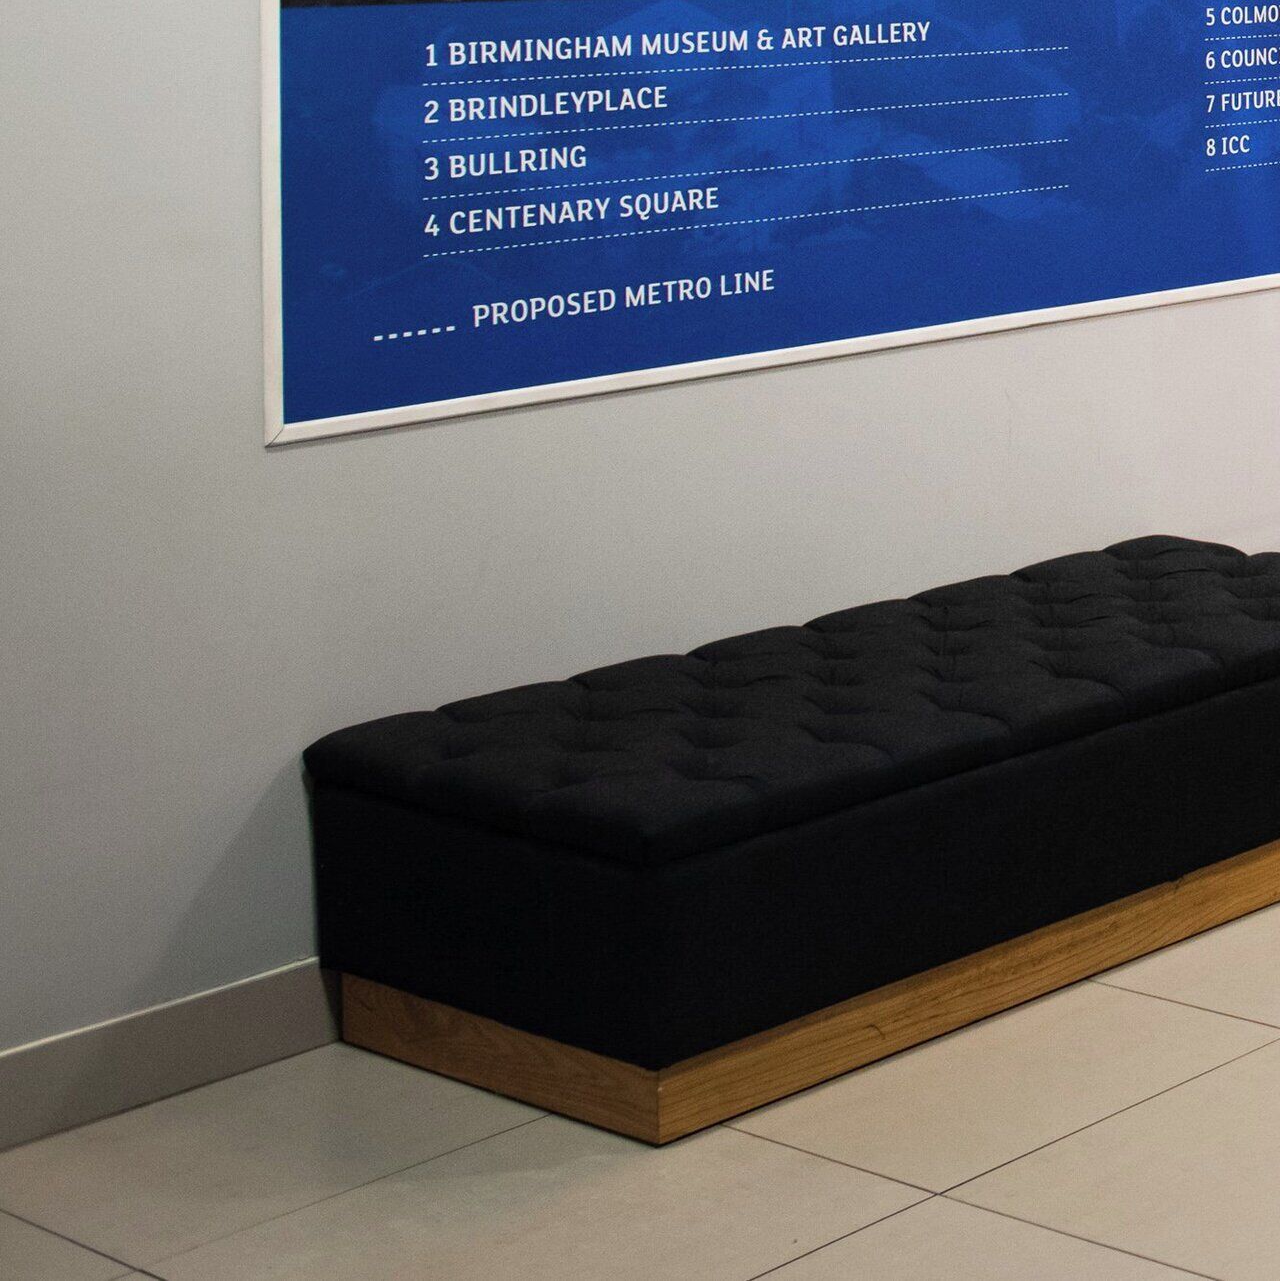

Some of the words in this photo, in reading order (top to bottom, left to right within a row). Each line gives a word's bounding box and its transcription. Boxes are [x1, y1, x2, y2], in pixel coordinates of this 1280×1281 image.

[1206, 7, 1216, 26] 5
[425, 43, 438, 67] 1
[448, 34, 632, 66] BIRMINGHAM
[641, 29, 748, 56] MUSEUM
[756, 28, 774, 51] &
[781, 26, 827, 49] ART
[832, 21, 930, 47] GALLERY
[1205, 51, 1216, 70] 6
[424, 100, 439, 124] 2
[449, 87, 668, 123] BRINDLEYPLACE
[1206, 94, 1216, 113] 7
[424, 156, 439, 181] 3
[448, 145, 587, 179] BULLRING
[1206, 138, 1216, 157] 8
[1221, 134, 1250, 155] ICC
[424, 214, 440, 237] 4
[449, 196, 611, 235] CENTENARY
[619, 187, 719, 221] SQUARE
[472, 288, 616, 328] PROPOSED
[625, 276, 712, 308] METRO
[720, 269, 775, 296] LINE
